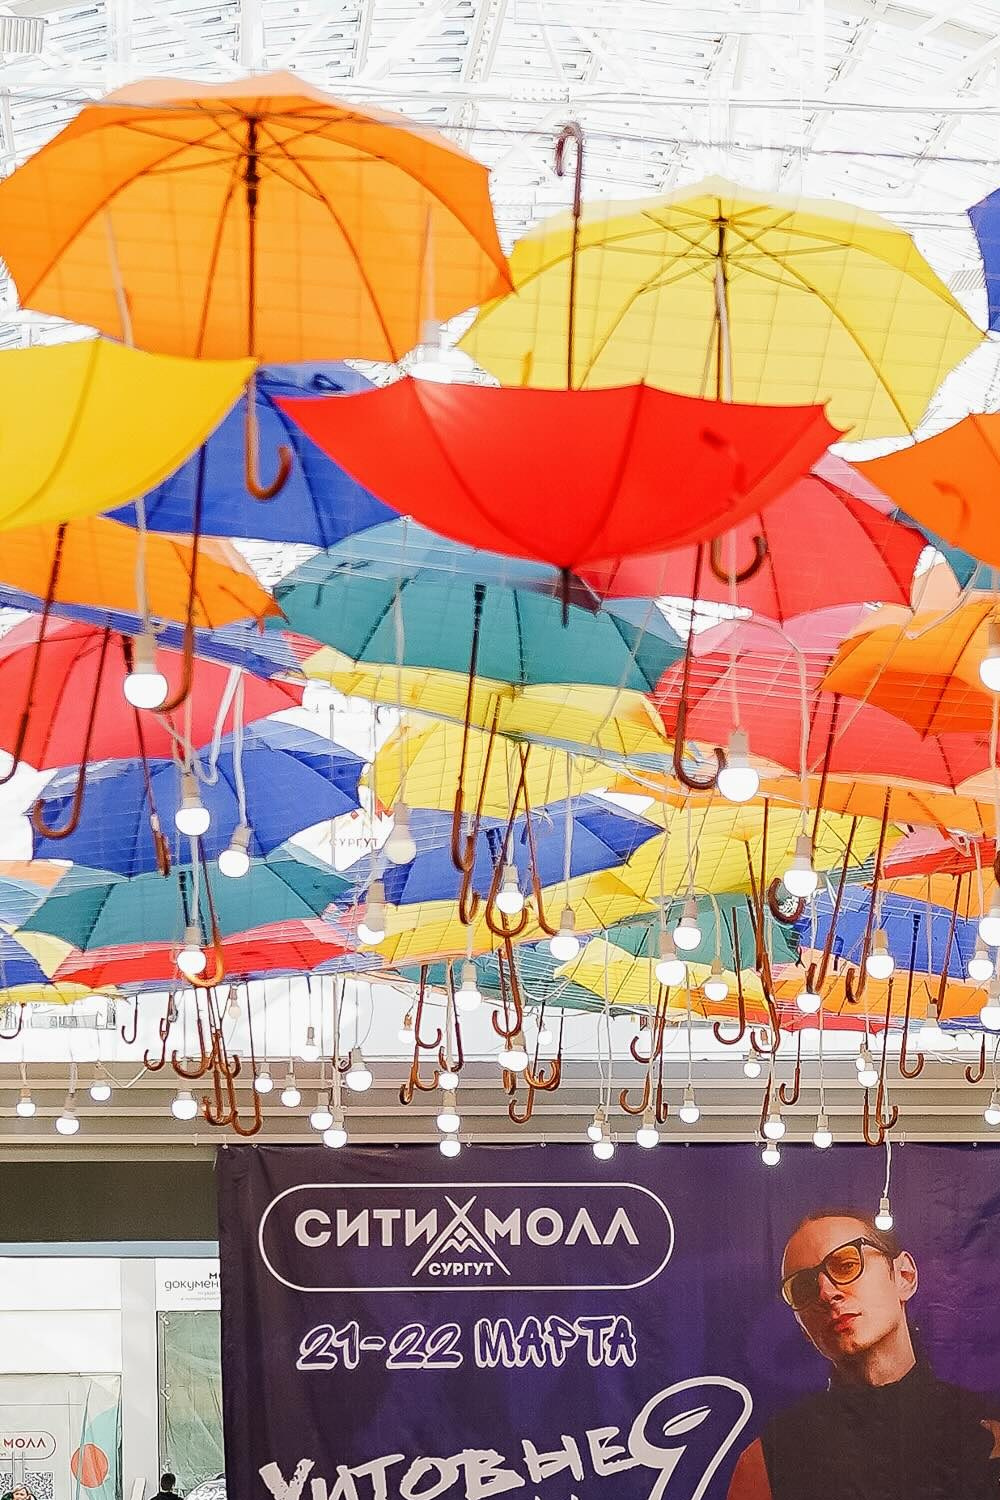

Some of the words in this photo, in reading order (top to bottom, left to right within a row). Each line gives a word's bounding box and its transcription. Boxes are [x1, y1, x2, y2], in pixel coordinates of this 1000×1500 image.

[428, 1262, 494, 1276] СУРГУТ
[164, 1280, 220, 1292] докумен
[296, 1321, 463, 1370] 21-22
[474, 1315, 636, 1368] МАРТА
[3, 1438, 46, 1449] МОЛЛ
